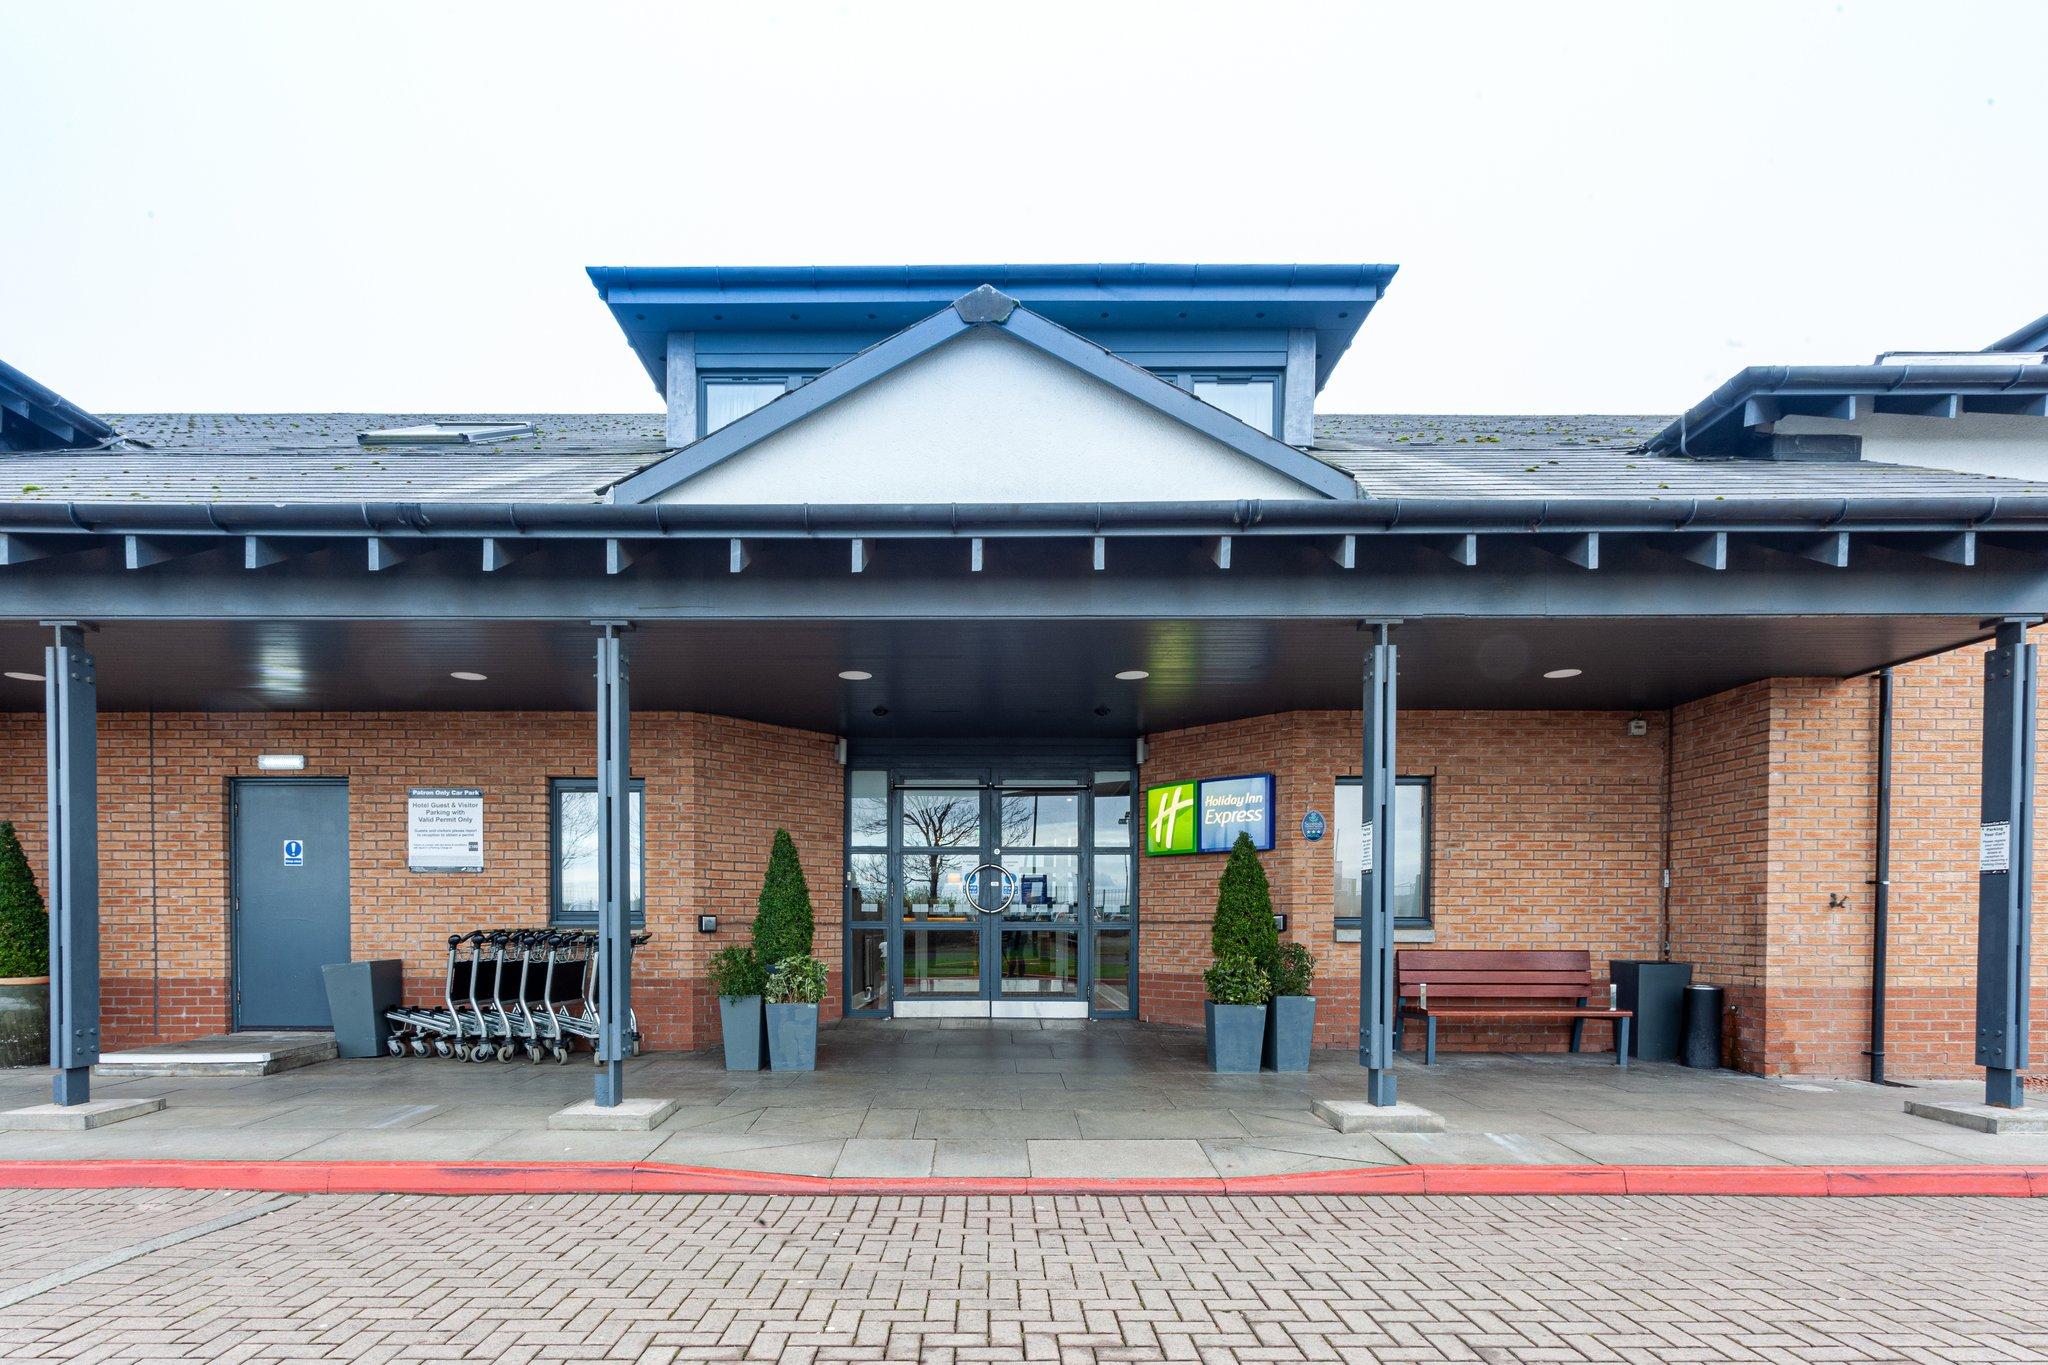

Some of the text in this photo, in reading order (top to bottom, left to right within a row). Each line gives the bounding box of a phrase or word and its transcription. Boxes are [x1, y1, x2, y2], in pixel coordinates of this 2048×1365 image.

[1204, 792, 1263, 807] Holiday Inn
[1204, 809, 1263, 827] Express
